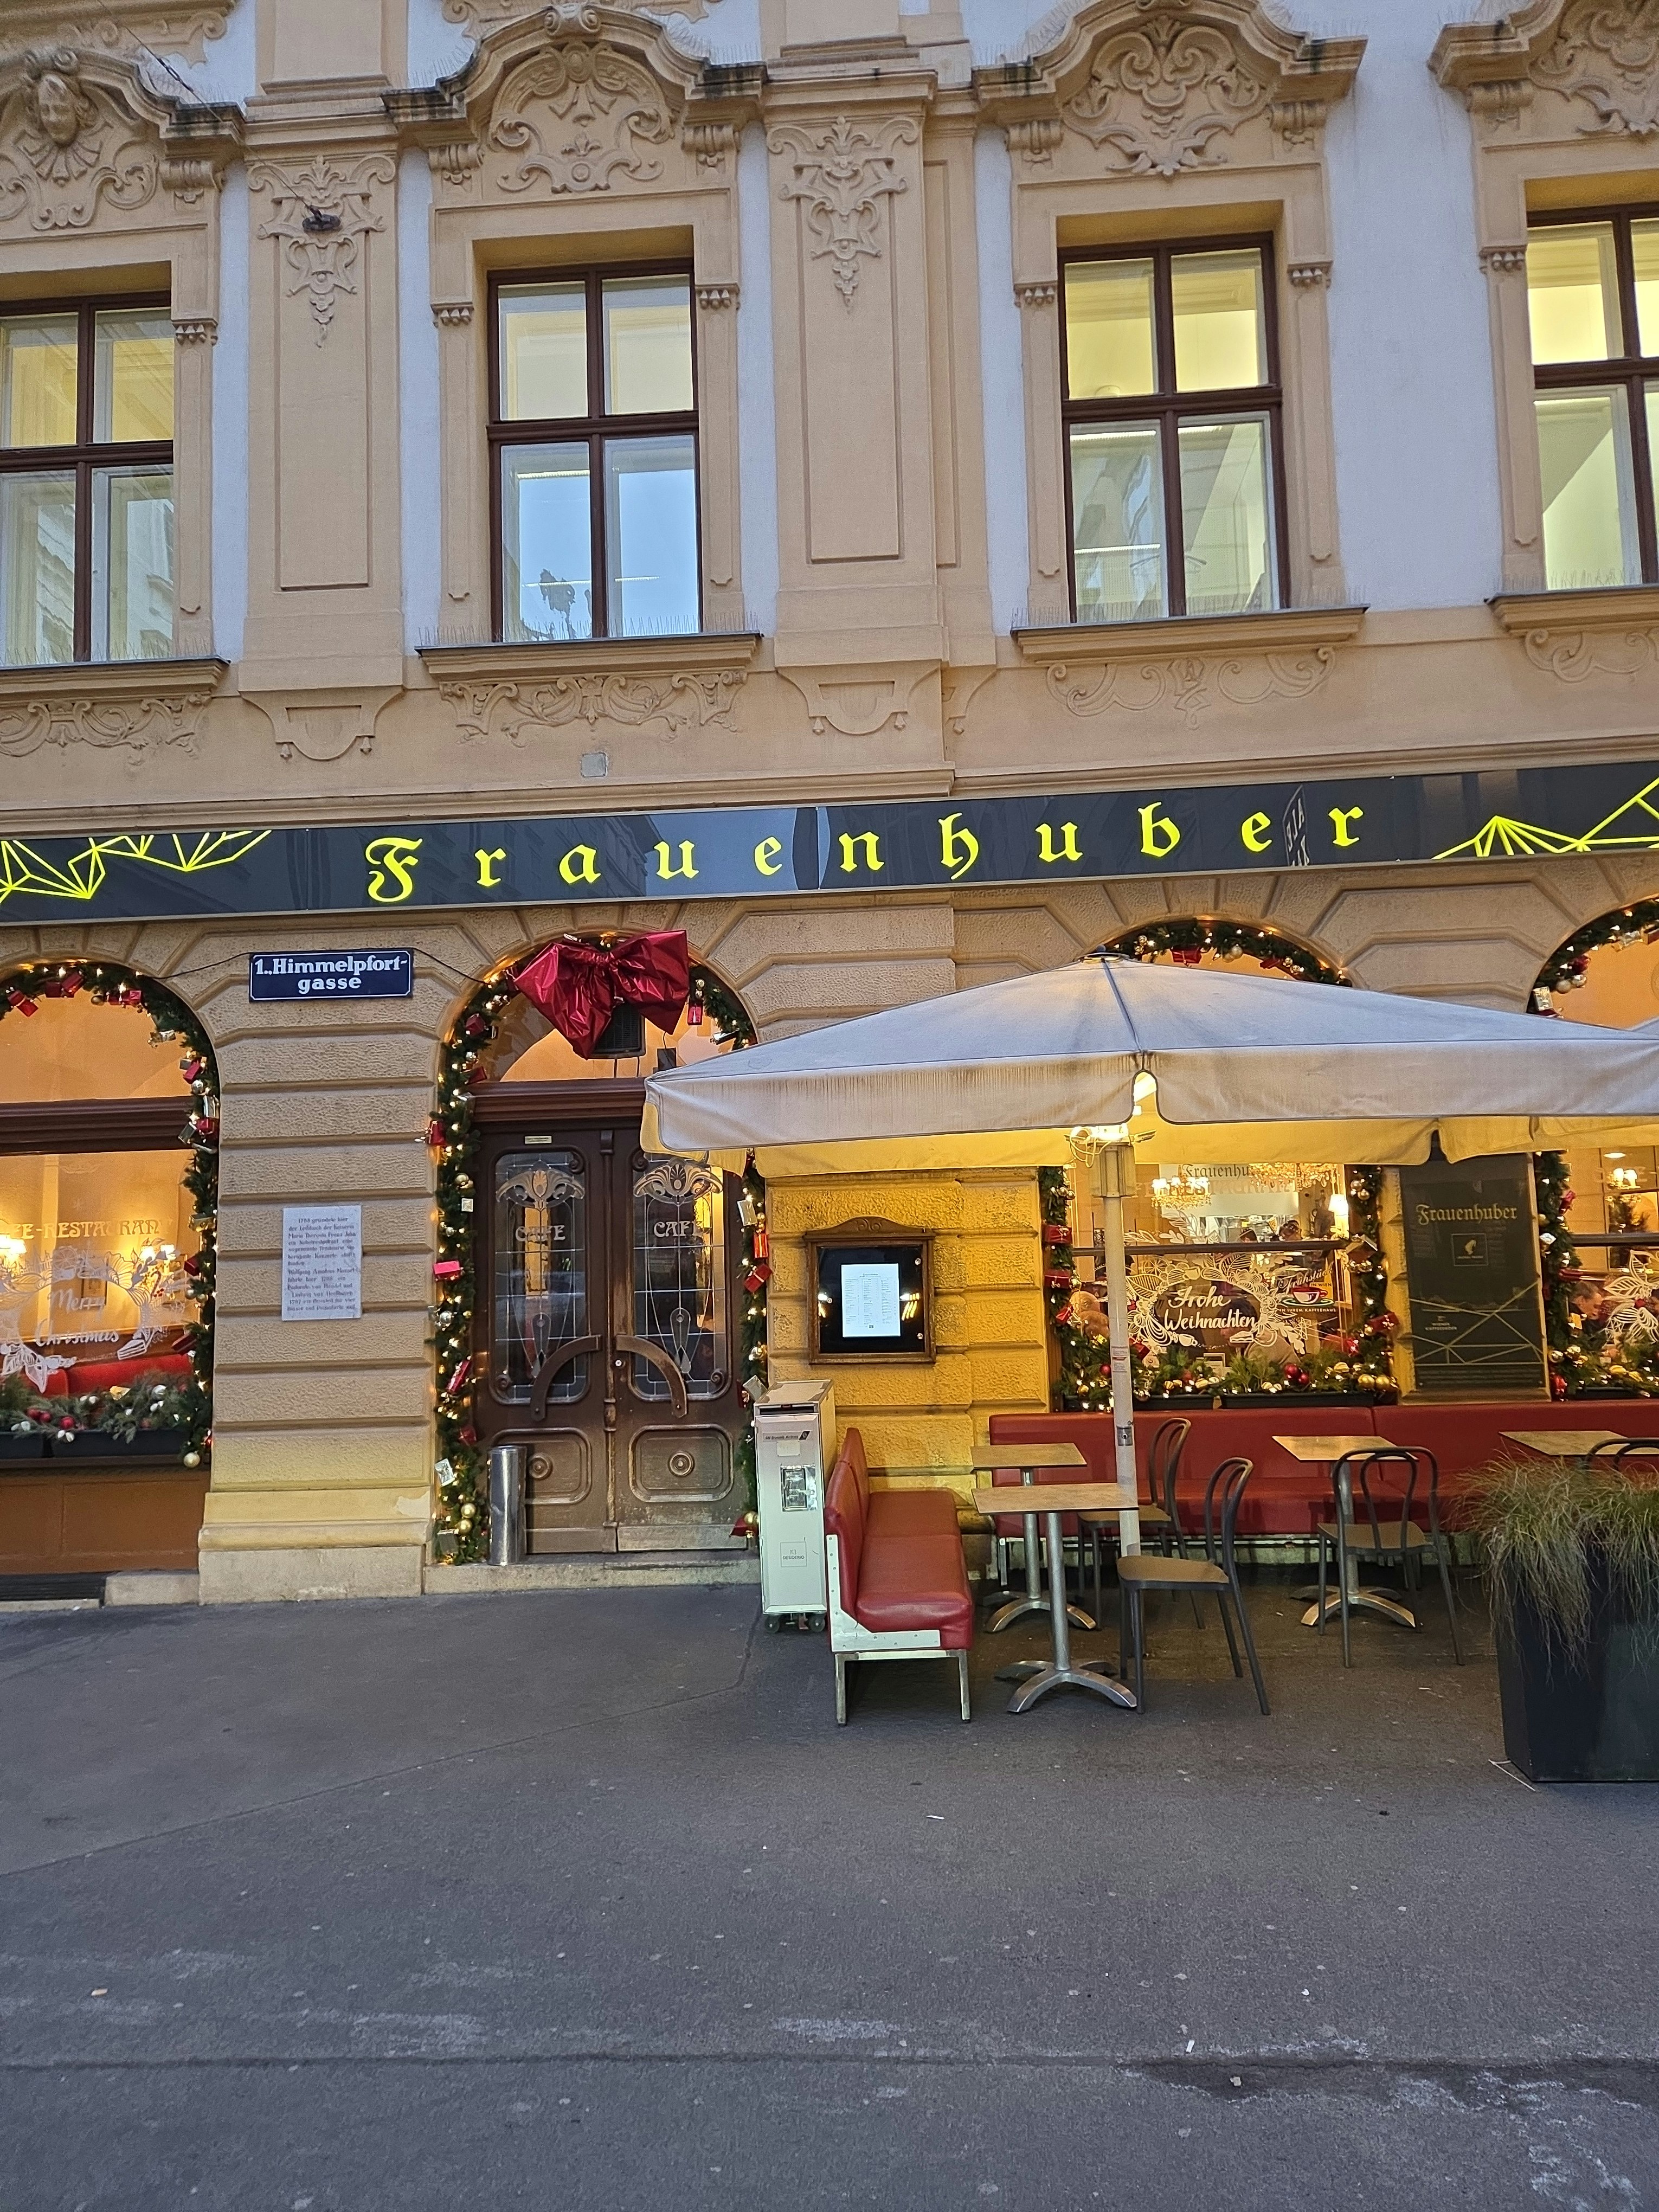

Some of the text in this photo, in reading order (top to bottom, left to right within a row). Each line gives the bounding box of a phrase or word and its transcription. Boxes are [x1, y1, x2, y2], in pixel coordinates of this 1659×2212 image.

[366, 801, 1365, 903] Frauenhuber
[298, 976, 362, 994] gasse
[1181, 1163, 1250, 1181] Frauenhu
[1416, 1203, 1519, 1226] Frauenhuber
[48, 1288, 106, 1321] Merry
[1168, 1285, 1231, 1308] Frohe
[1164, 1309, 1256, 1330] Weihnachten
[35, 1318, 119, 1347] Christmas
